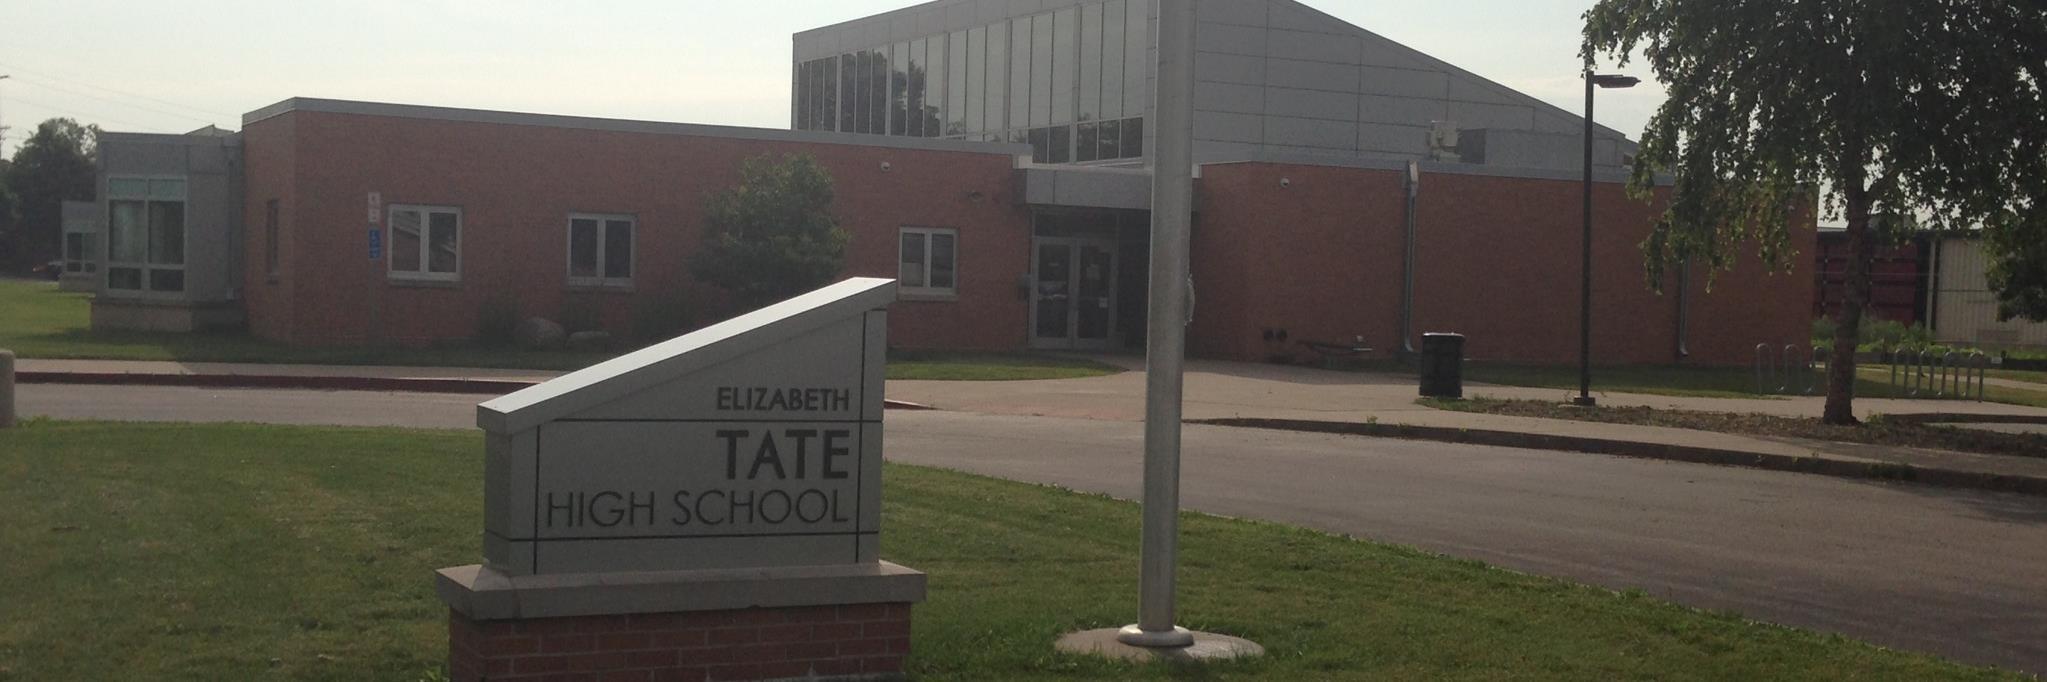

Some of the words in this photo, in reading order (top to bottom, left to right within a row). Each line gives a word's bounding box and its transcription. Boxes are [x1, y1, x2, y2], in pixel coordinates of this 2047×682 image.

[717, 386, 849, 412] ELIZABETH
[716, 429, 850, 480] TATE
[547, 490, 655, 527] HIGH
[672, 488, 850, 526] SCHOOL
